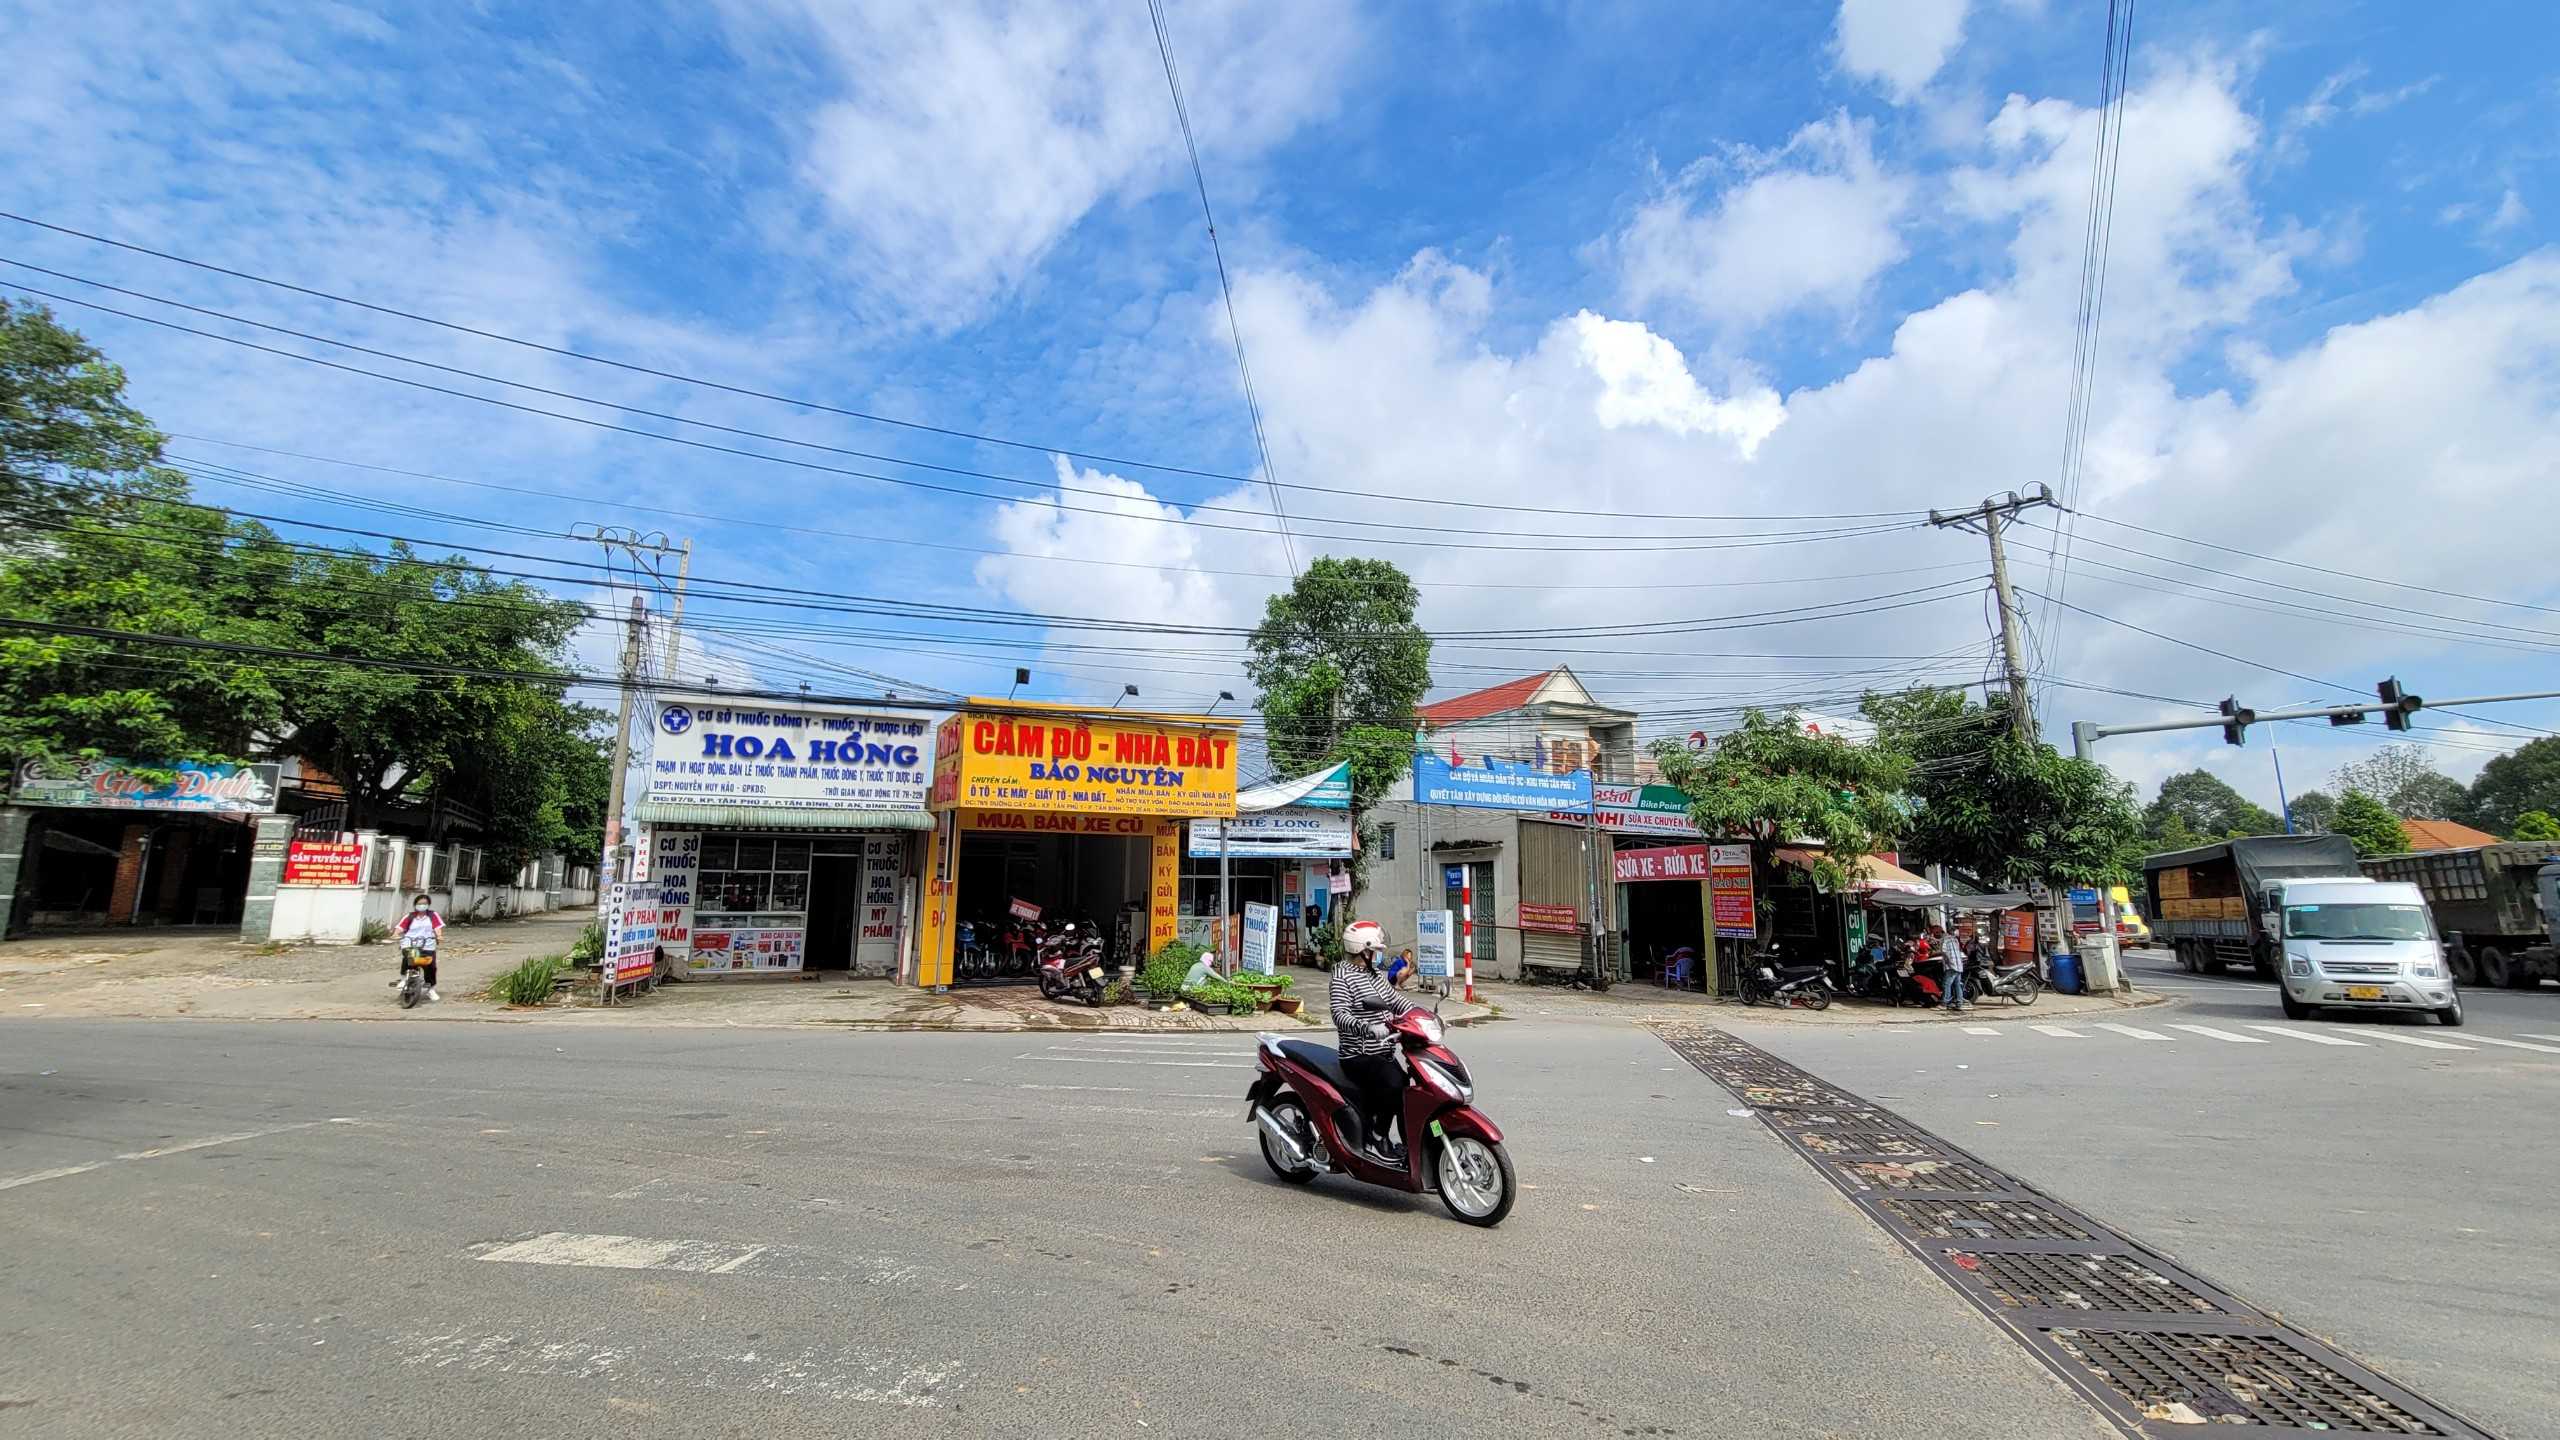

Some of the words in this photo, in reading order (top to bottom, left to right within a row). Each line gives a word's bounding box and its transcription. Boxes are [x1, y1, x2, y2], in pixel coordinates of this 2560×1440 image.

[697, 709, 713, 722] CƠ
[716, 708, 732, 723] SỞ
[736, 711, 770, 726] THUỐC
[773, 712, 802, 728] ĐÔNG
[804, 718, 811, 728] Y
[823, 717, 855, 731] THUỐC
[859, 719, 871, 732] TỪ
[874, 722, 901, 736] DƯỢC
[902, 722, 923, 738] LIỆU
[702, 733, 796, 759] HOA
[808, 731, 919, 767] HỒNG
[973, 716, 1045, 758] CẦM
[1051, 719, 1092, 761] ĐỒ
[1116, 728, 1171, 766] NHÀ
[1177, 729, 1229, 769] ĐẤT
[656, 760, 676, 775] PHẠM
[680, 762, 686, 774] VI
[689, 762, 705, 776] HOẠT
[729, 763, 742, 776] BÁN
[755, 763, 775, 777] THUỐC
[777, 764, 797, 778] THÀNH
[821, 766, 840, 780] THUỐC
[841, 767, 857, 781] ĐÔNG
[867, 767, 884, 782] THUỐC
[912, 771, 924, 785] LIỆU
[1030, 758, 1080, 782] BẢO
[1086, 763, 1184, 787] NGUYÊN
[705, 783, 718, 792] HUY
[840, 788, 856, 797] GIAN
[979, 785, 990, 797] TÔ
[997, 788, 1008, 798] XE
[1010, 786, 1029, 799] MÁY
[1035, 787, 1054, 800] GIẤY
[1138, 789, 1154, 797] MUA
[1156, 789, 1170, 797] BÁN
[1595, 788, 1632, 803] astrol
[1640, 799, 1658, 809] Bike
[1659, 801, 1681, 810] Point
[977, 813, 1028, 830] MUA
[1033, 812, 1077, 832] BÁN
[1079, 816, 1110, 832] XE
[1115, 815, 1144, 834] CŨ
[1274, 818, 1320, 829] LONG
[1644, 815, 1652, 825] XE
[1654, 813, 1683, 828] CHUYÊN
[1156, 824, 1177, 837] MUA
[660, 837, 677, 851] CƠ
[682, 835, 699, 851] SỞ
[868, 842, 881, 854] CƠ
[886, 839, 899, 855] SỞ
[1156, 844, 1176, 857] BÁN
[659, 852, 696, 868] THUỐC
[867, 858, 898, 871] THUỐC
[1617, 853, 1638, 878] SỬA
[1641, 857, 1655, 877] XE
[1664, 850, 1685, 876] RỬA
[1689, 855, 1705, 875] XE
[1158, 864, 1173, 877] KÝ
[663, 874, 687, 887] HOA
[871, 876, 891, 888] HOA
[866, 889, 894, 904] HỒNG
[1156, 882, 1173, 897] GỬI
[662, 909, 681, 925] MỸ
[871, 907, 887, 921] MỸ
[1155, 905, 1175, 917] NHÀ
[1246, 917, 1268, 933] THUỐC
[1419, 919, 1444, 934] THUỐC
[1848, 910, 1859, 928] CŨ
[863, 921, 893, 938] PHẨM
[1155, 924, 1174, 937] ĐẤT
